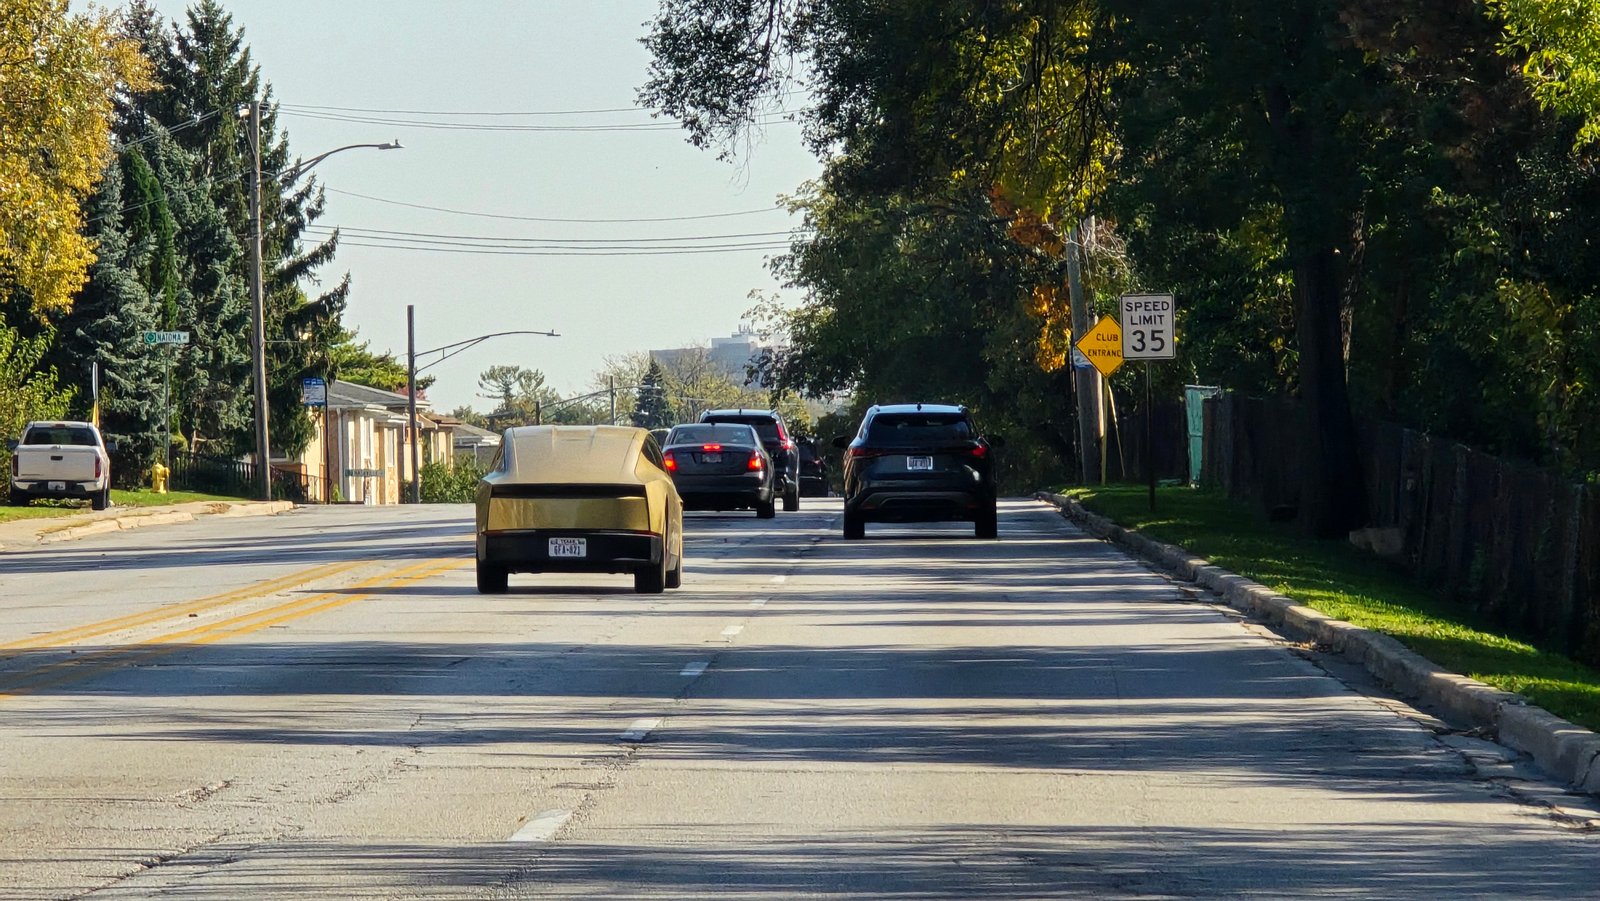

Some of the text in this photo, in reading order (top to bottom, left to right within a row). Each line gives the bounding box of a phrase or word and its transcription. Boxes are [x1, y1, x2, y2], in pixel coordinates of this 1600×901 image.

[1125, 301, 1170, 312] SPEED
[1130, 314, 1165, 326] LIMIT
[156, 332, 182, 342] NATOMA
[1096, 333, 1119, 342] CLUB
[1131, 329, 1165, 353] 35
[1087, 348, 1121, 357] ENTRANC
